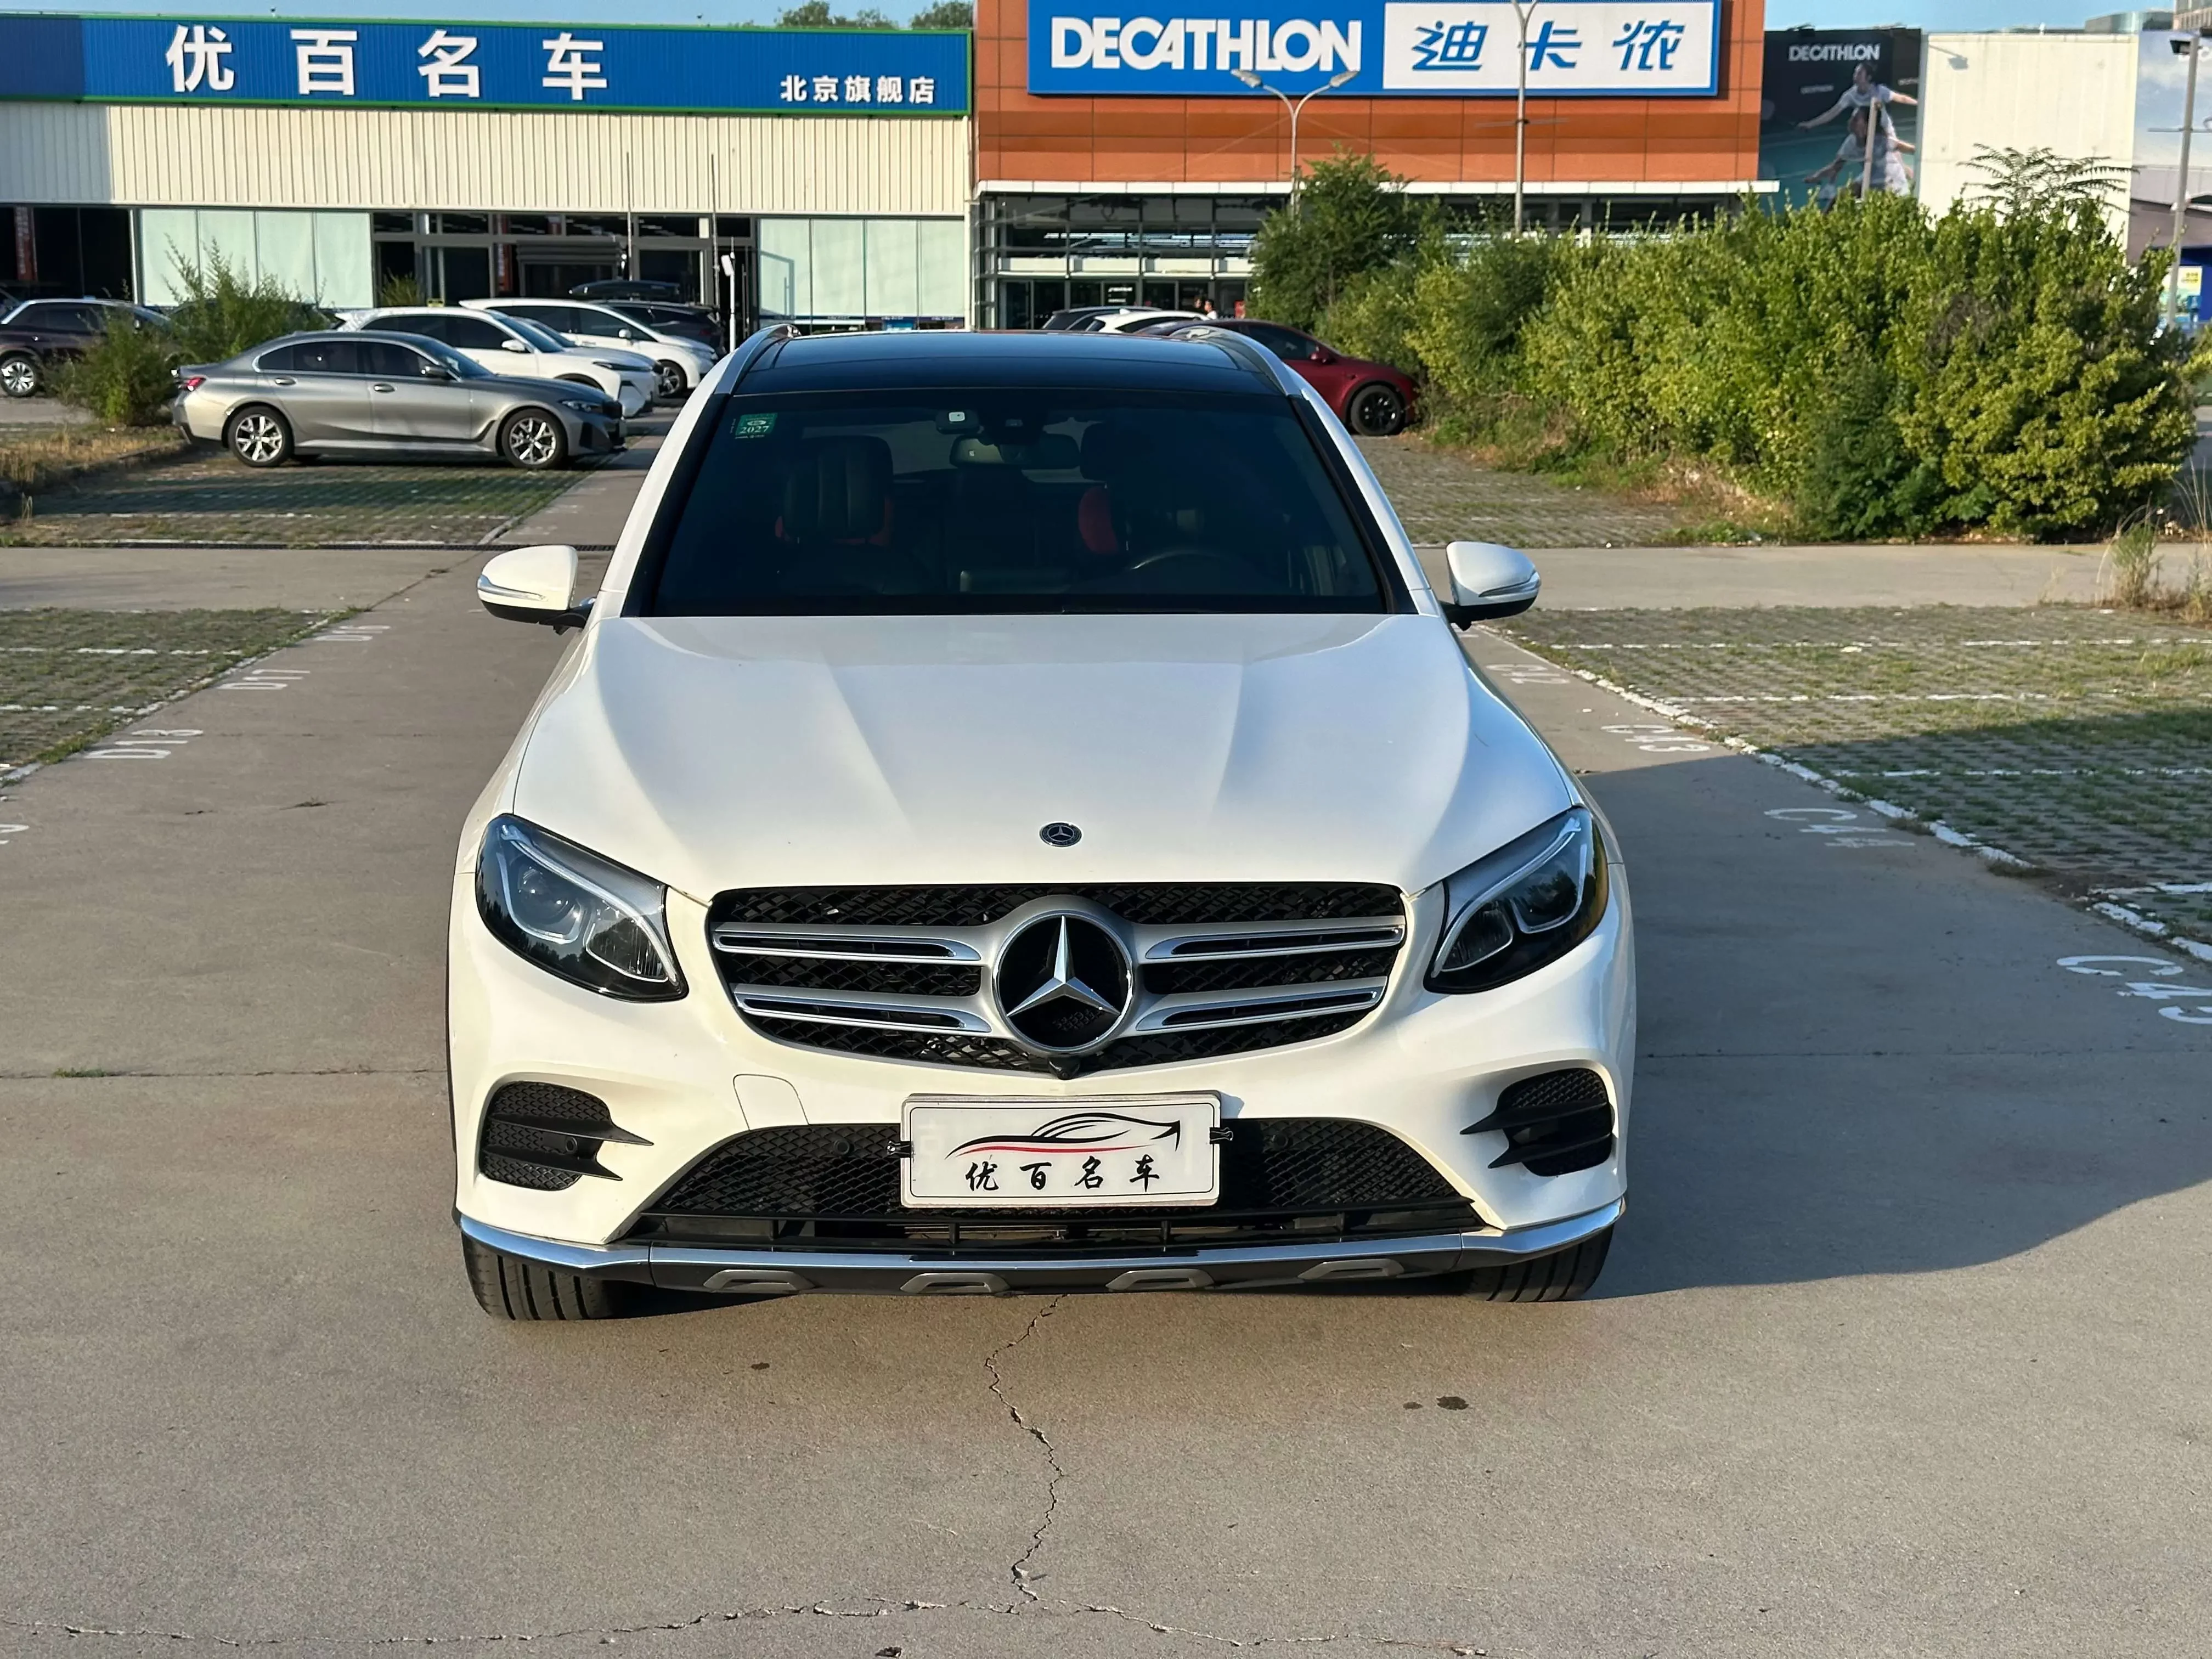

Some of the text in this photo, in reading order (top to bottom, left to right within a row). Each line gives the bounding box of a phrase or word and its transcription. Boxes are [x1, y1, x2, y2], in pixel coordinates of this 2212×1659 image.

[165, 25, 607, 101] 优百名车
[1051, 16, 1362, 72] DECATHLON
[1412, 20, 1686, 71] 迪卡侬
[1788, 44, 1880, 61] DECATHLON
[780, 75, 935, 104] 北京旗舰店
[739, 425, 770, 434] 2027
[964, 1154, 1161, 1193] 优百名车
